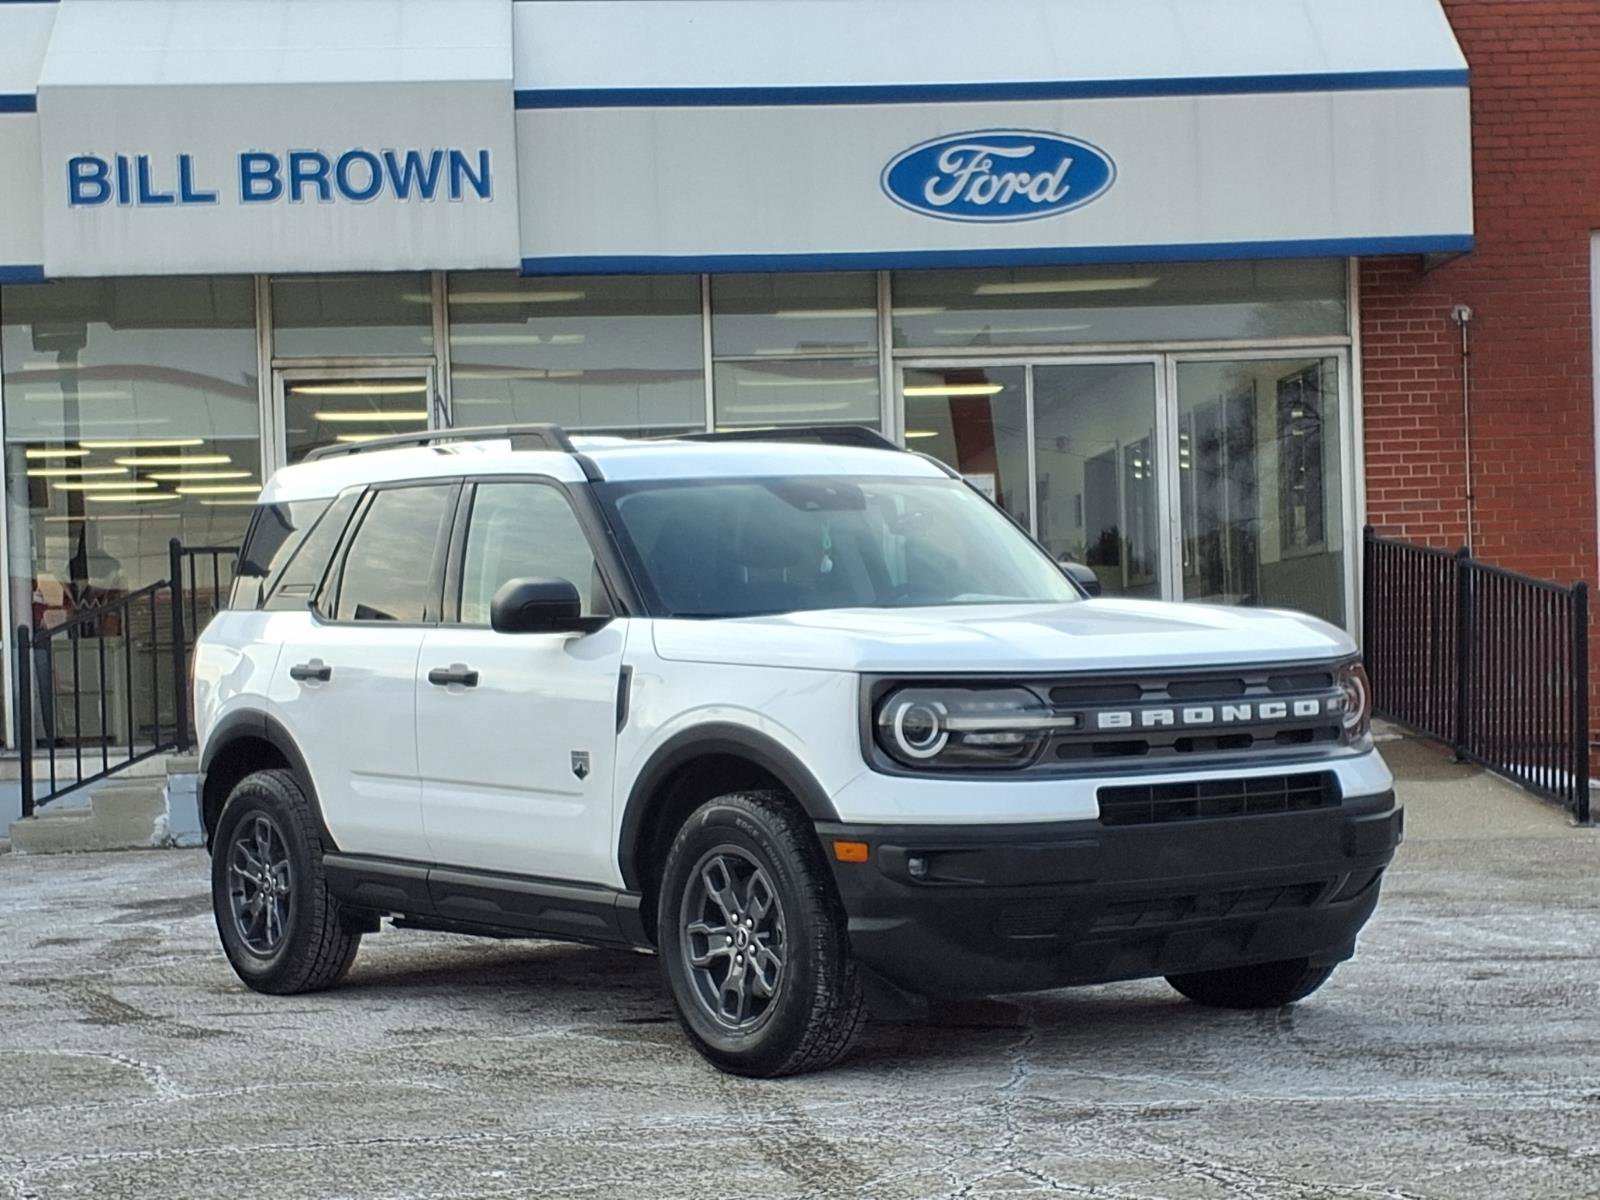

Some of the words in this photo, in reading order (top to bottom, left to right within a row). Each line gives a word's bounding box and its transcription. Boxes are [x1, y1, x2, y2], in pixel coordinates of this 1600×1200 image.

[68, 153, 218, 207] BILL
[239, 148, 493, 203] BROWN
[924, 144, 1073, 206] Ford
[1098, 700, 1319, 728] BRONCO
